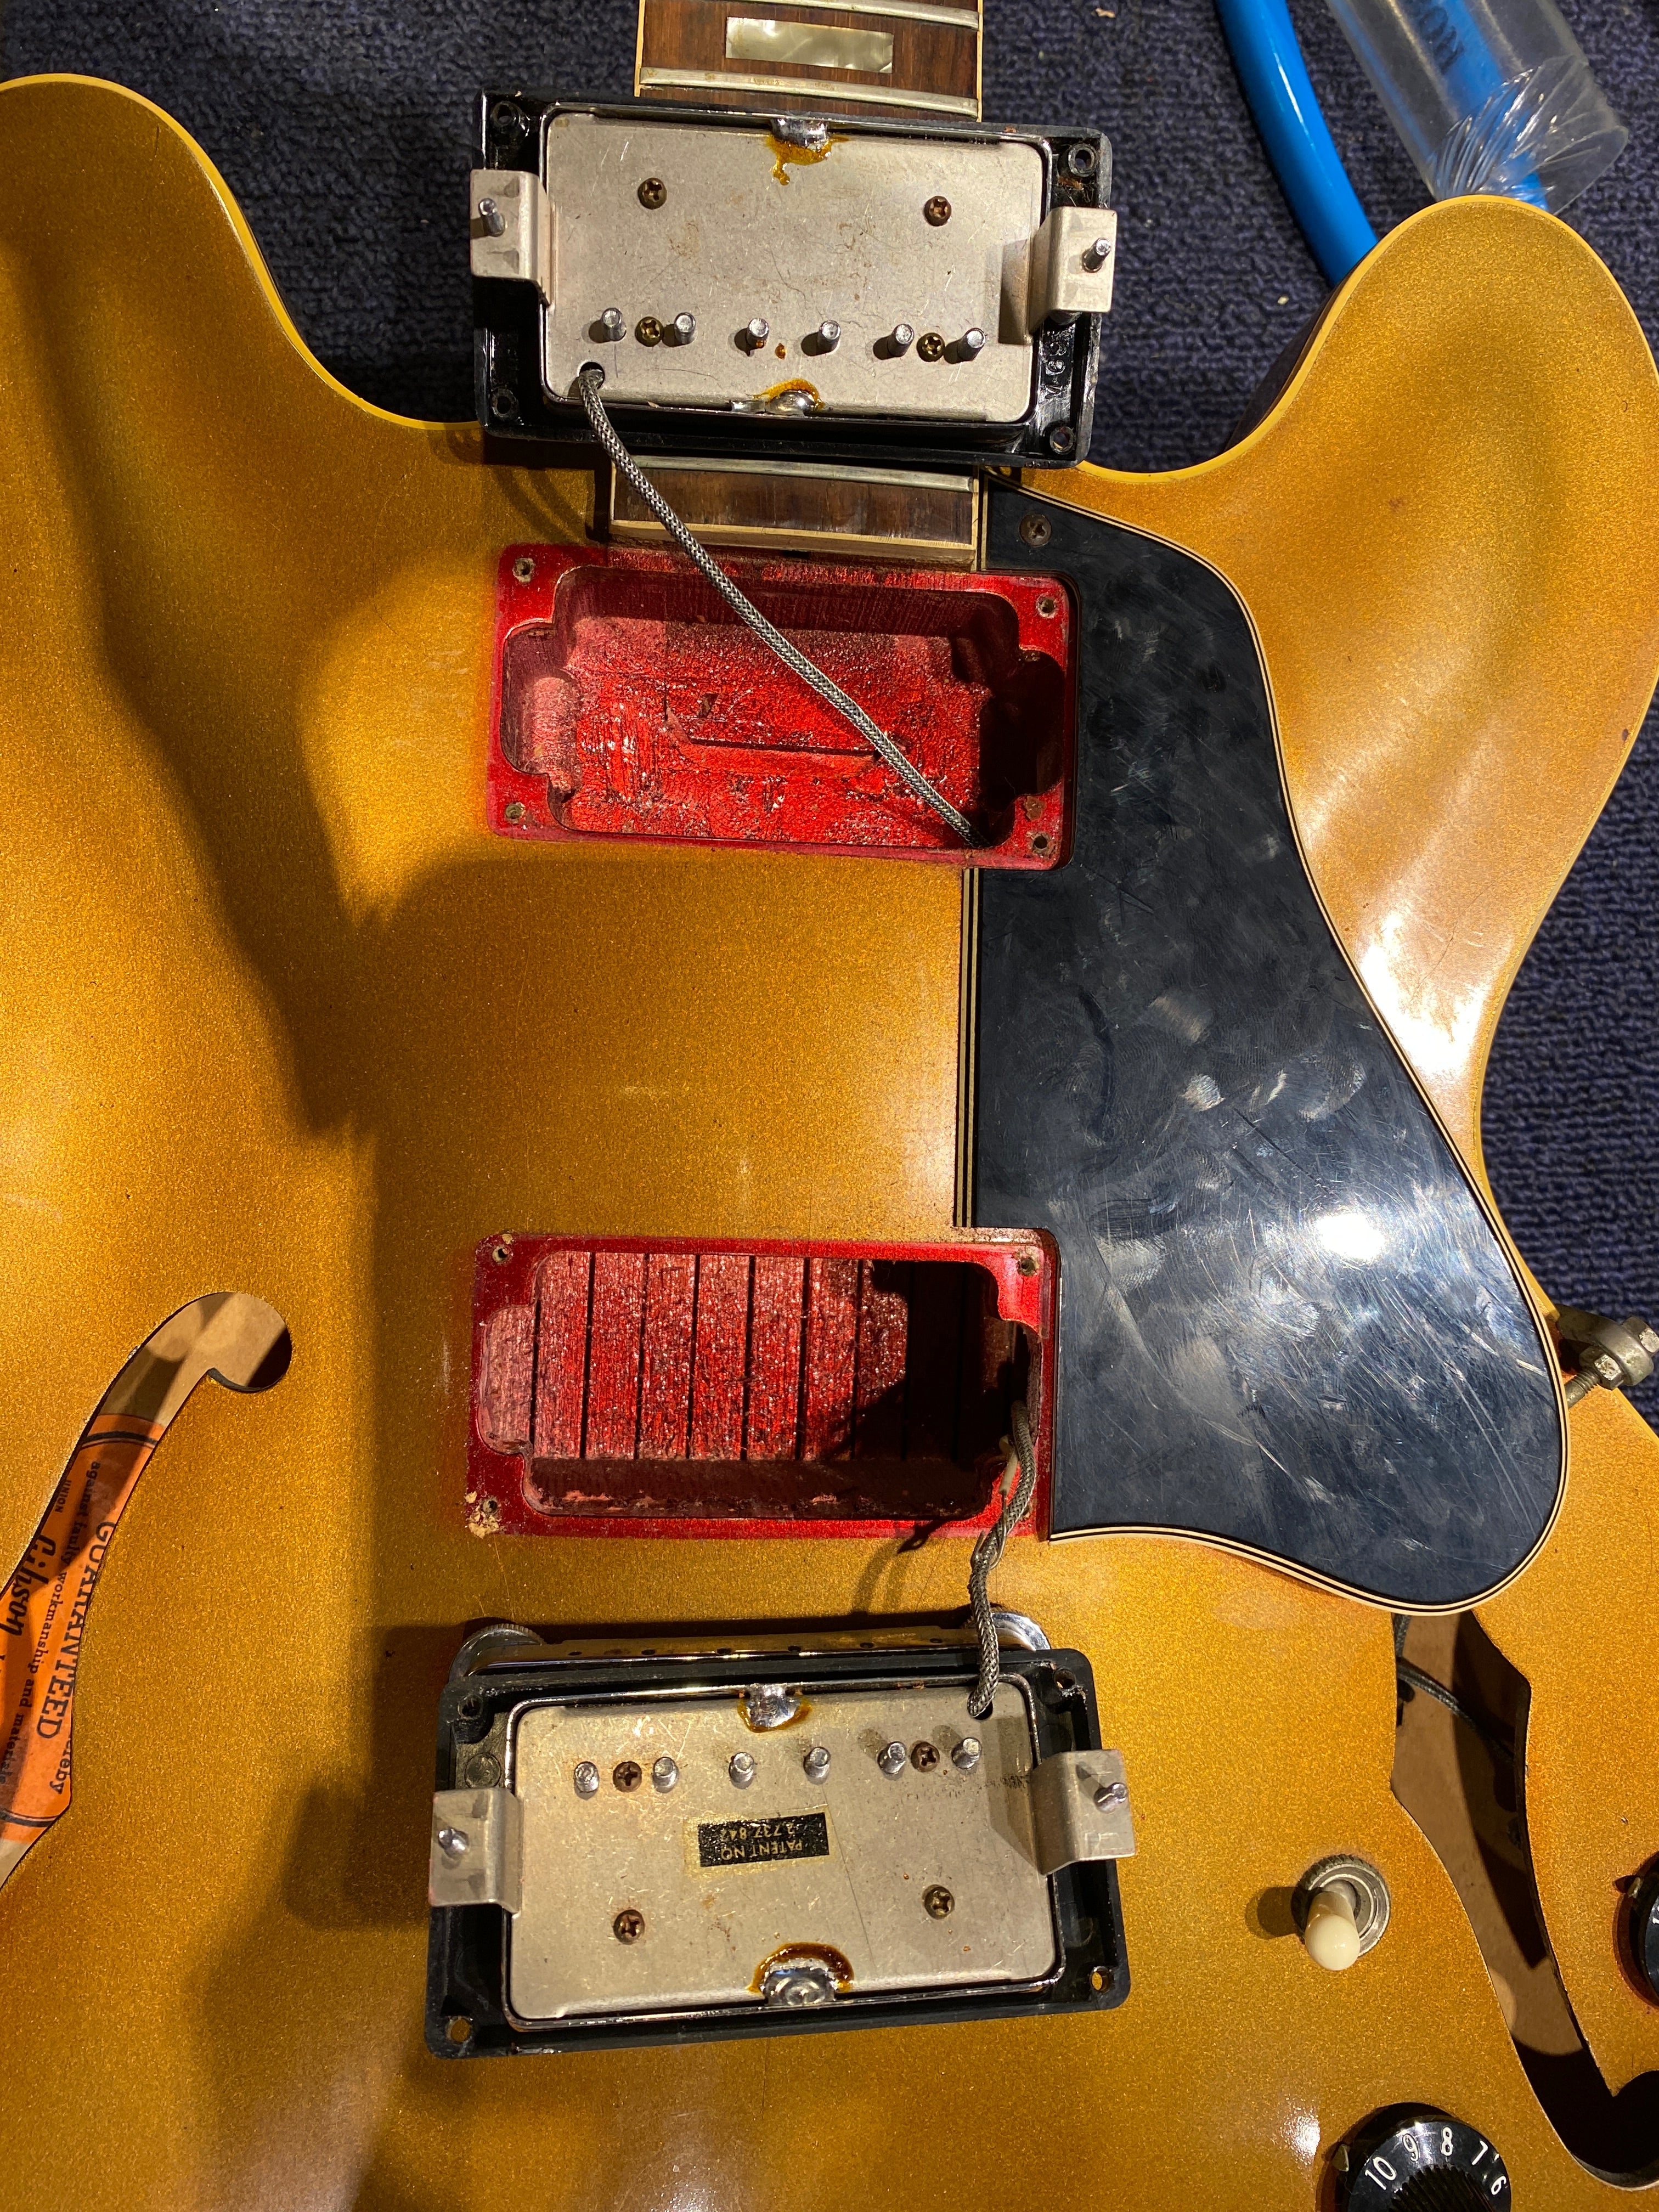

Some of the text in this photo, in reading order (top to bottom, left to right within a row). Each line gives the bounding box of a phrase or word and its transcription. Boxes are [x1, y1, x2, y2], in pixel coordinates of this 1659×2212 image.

[55, 1480, 72, 1513] UNION
[78, 1461, 101, 1517] against
[61, 1521, 88, 1564] faulty
[27, 1572, 67, 1674] workmanship
[19, 1679, 34, 1708] and
[750, 1838, 803, 1857] PATENT
[1364, 2126, 1507, 2196] 10 9 8 7 6
